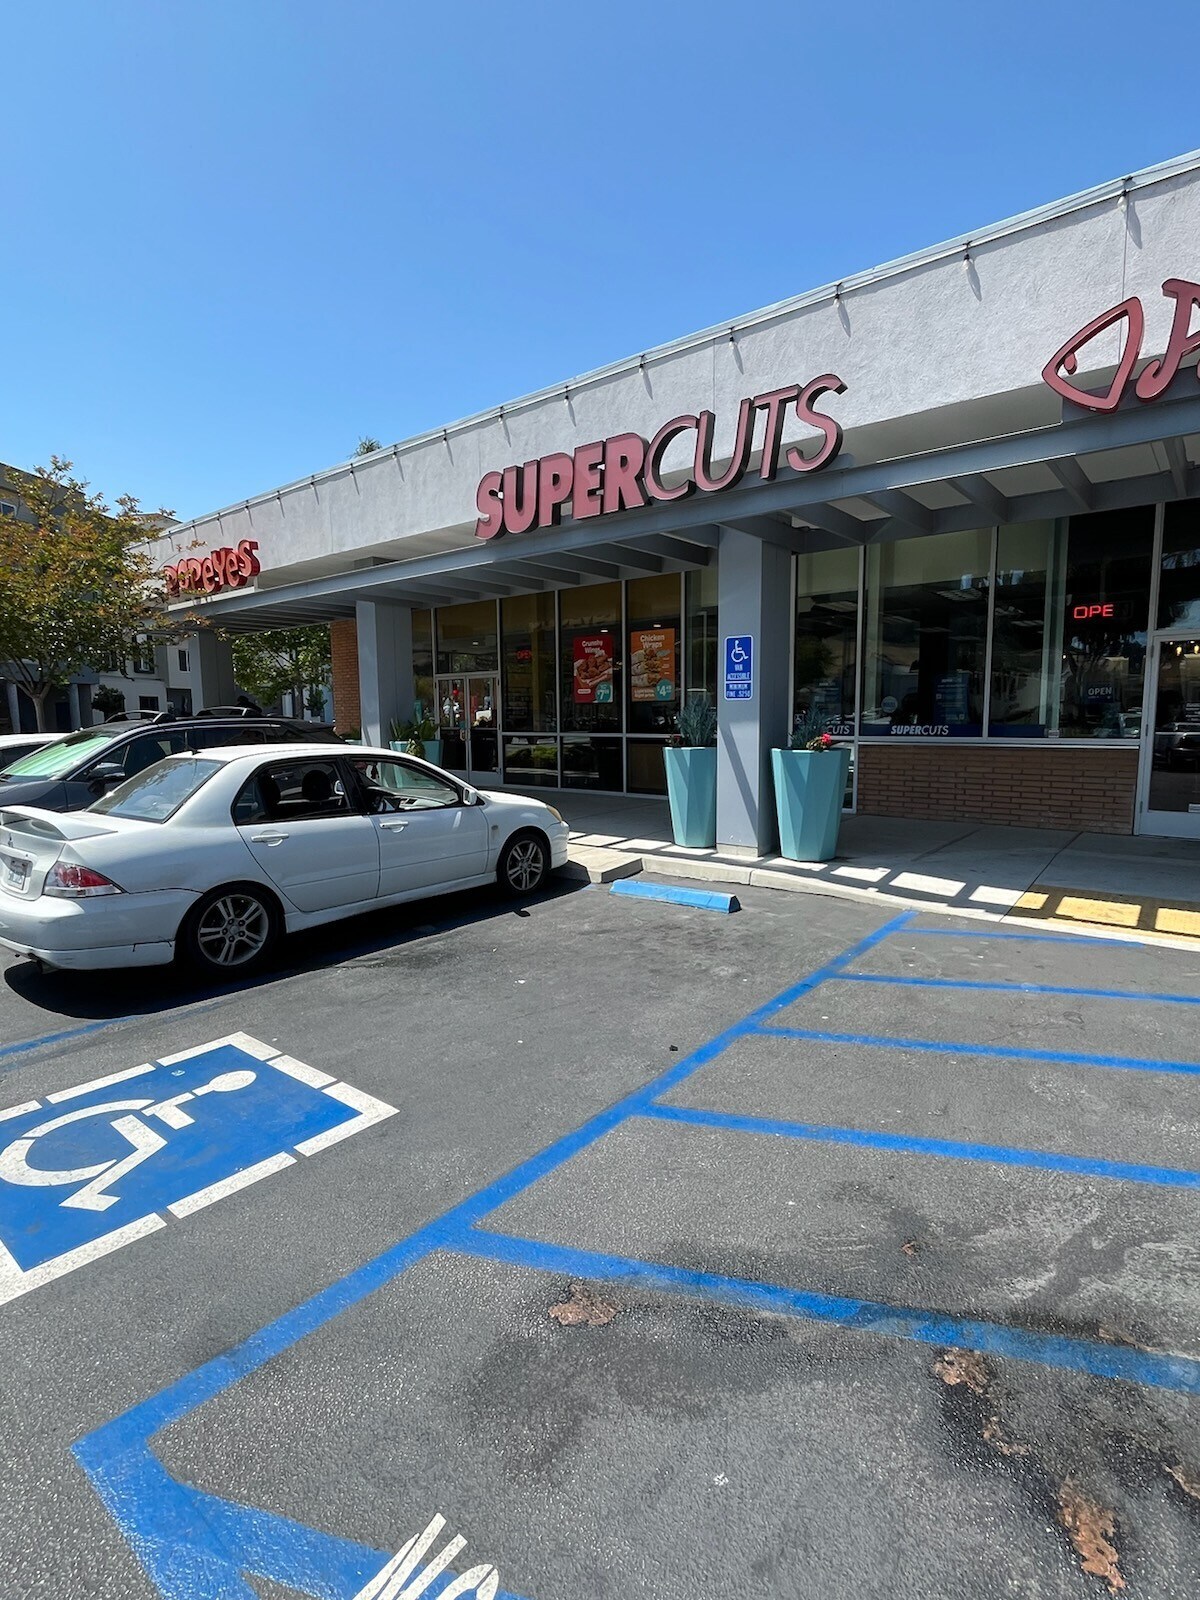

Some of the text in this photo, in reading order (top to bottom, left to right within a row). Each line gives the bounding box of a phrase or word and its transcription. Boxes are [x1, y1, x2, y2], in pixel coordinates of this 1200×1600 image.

[475, 373, 848, 541] SUPERCUTS
[640, 634, 664, 642] Chicken
[727, 672, 750, 680] ACCESSIBLE
[1088, 687, 1112, 696] OPEN
[890, 725, 949, 736] SUPERCUTS
